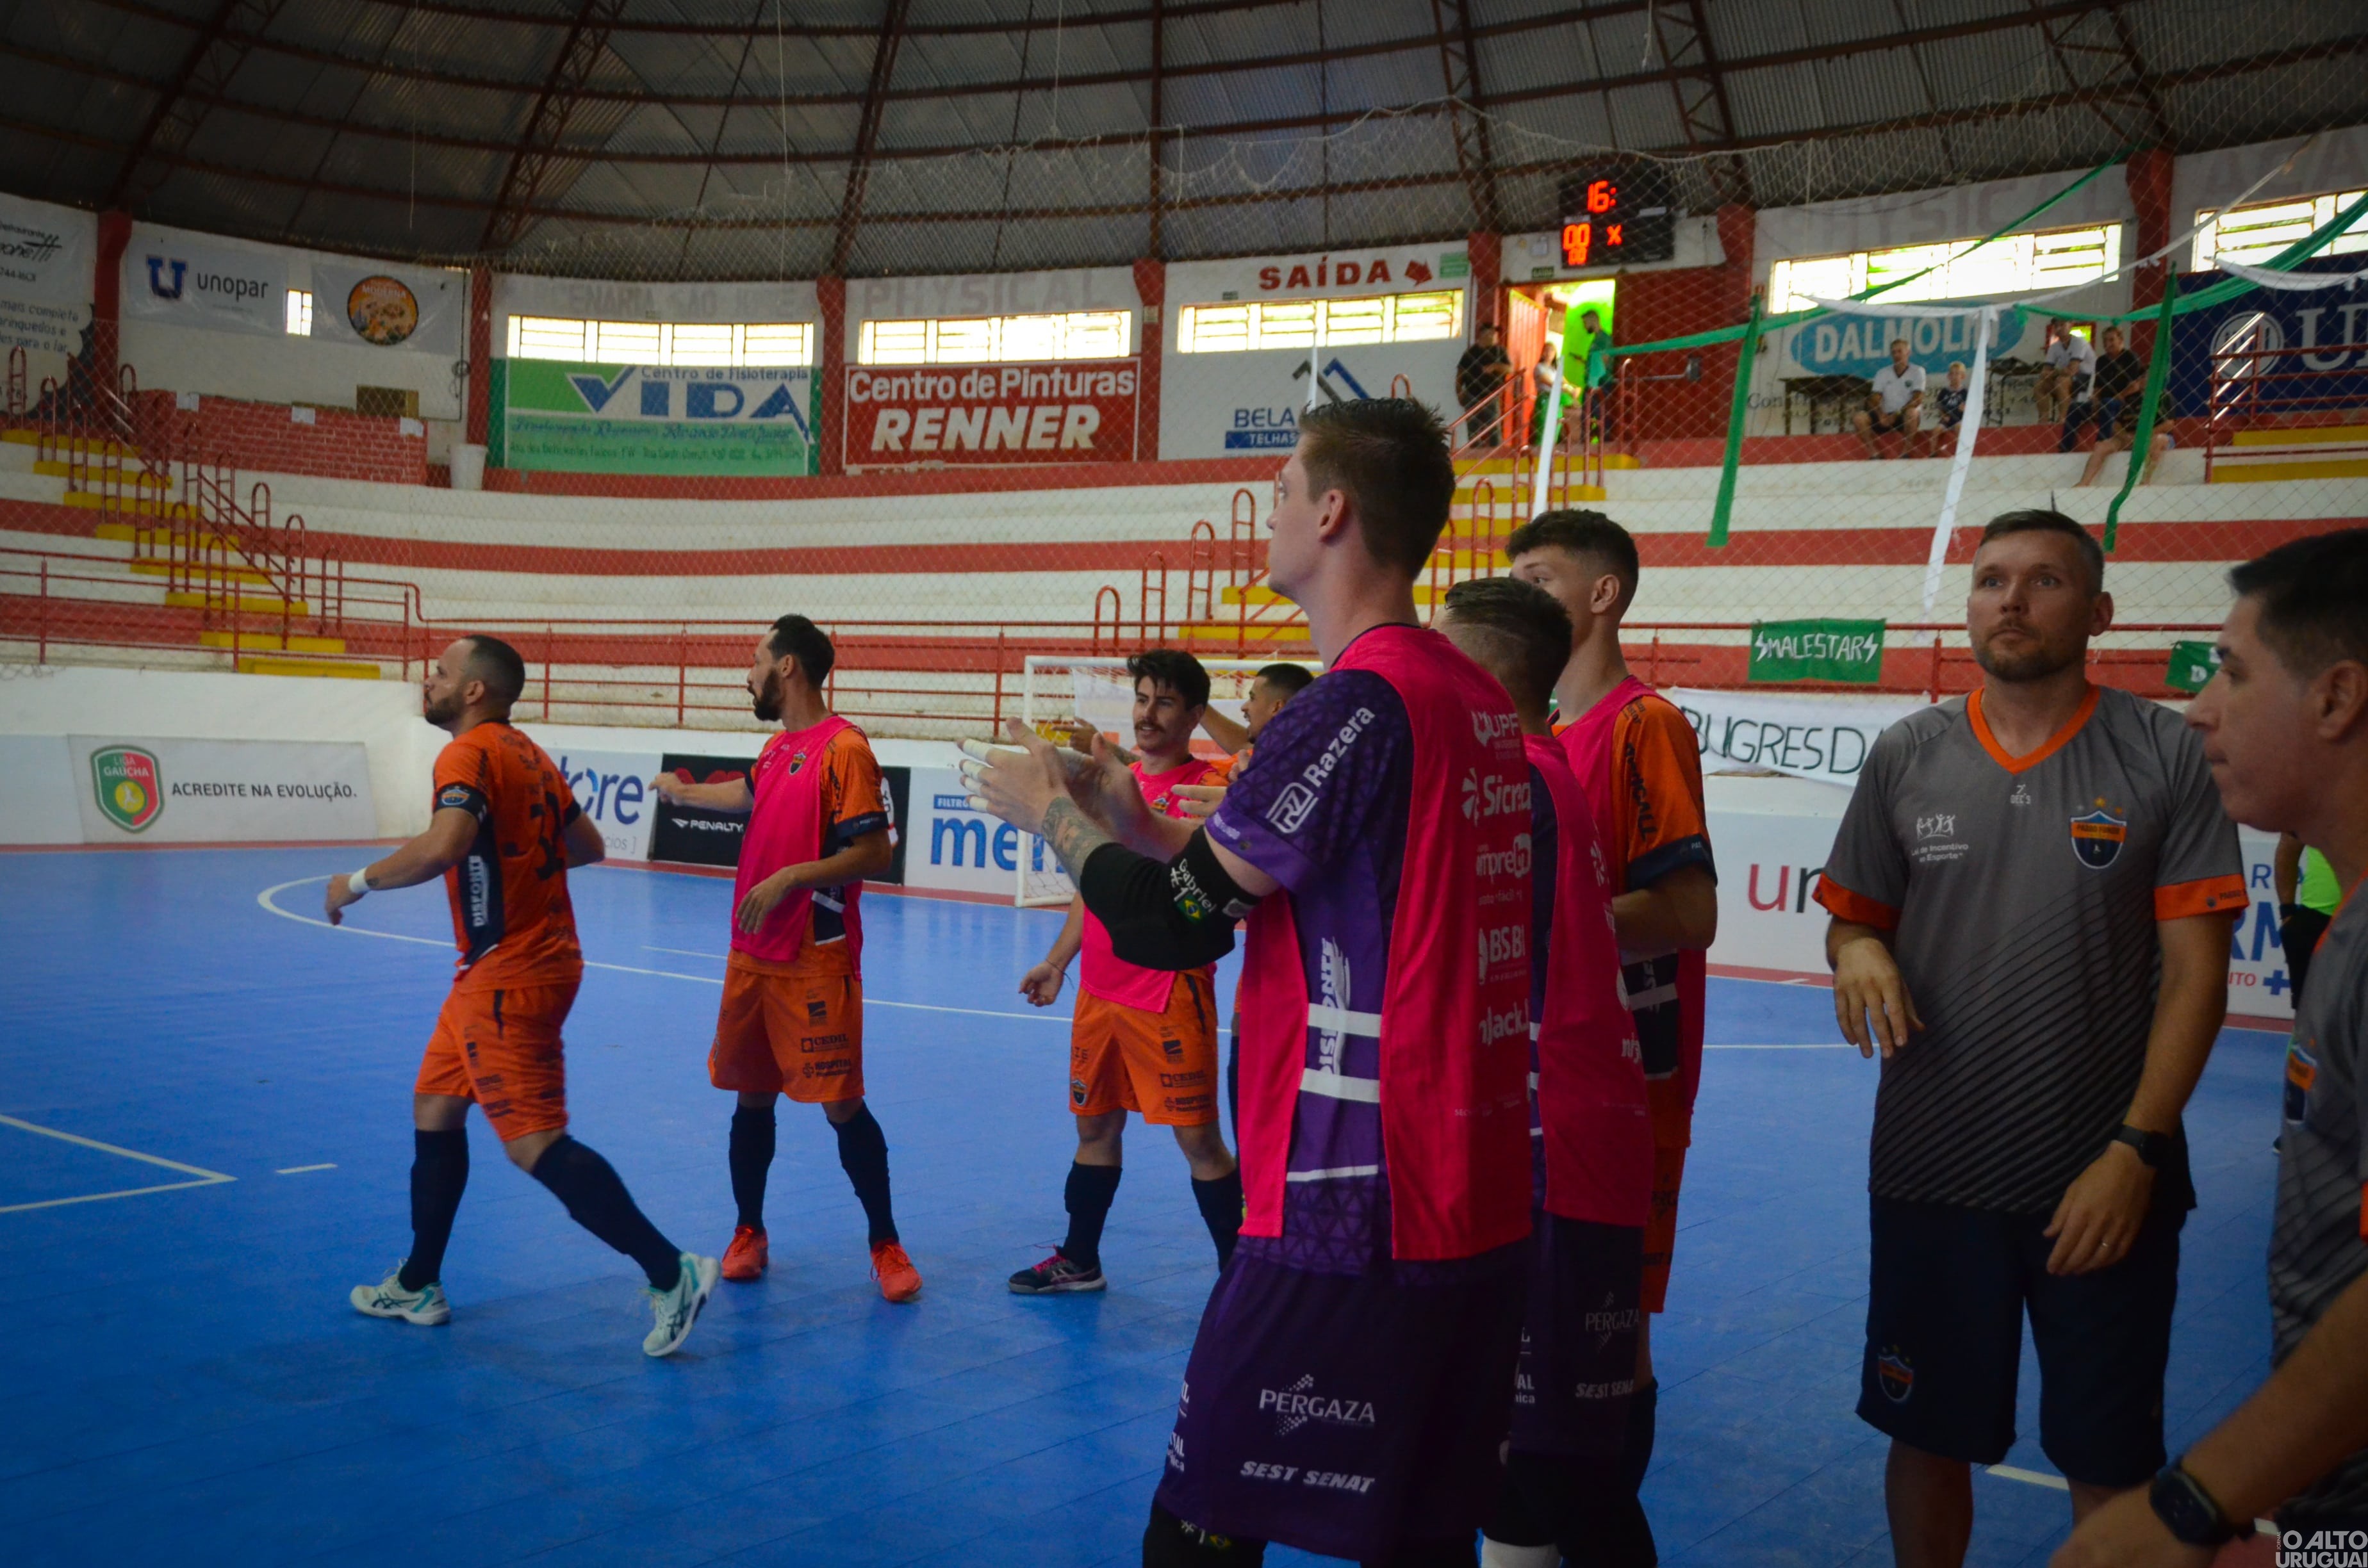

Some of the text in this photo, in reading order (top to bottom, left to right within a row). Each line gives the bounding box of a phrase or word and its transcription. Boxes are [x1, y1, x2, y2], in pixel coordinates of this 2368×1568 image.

[197, 272, 269, 301] unopar
[1259, 256, 1392, 290] SAÍDA
[863, 270, 1113, 318] PHYSICAL
[641, 367, 809, 382] Centro de Fisioterapia
[850, 367, 1135, 404] Centro de Pinturas
[569, 366, 814, 444] VIDA
[1234, 407, 1295, 427] BELA
[871, 404, 1101, 452] RENNER
[1250, 432, 1297, 446] TELHAS
[1303, 706, 1376, 788] Razera
[1681, 706, 1824, 771] BUGRES
[172, 781, 357, 803] ACREDITE NA EVOLUÇÃO.
[690, 819, 744, 833] PENALTY
[1927, 852, 1959, 862] Esporte
[1929, 842, 1969, 852] Incentivo
[1178, 858, 1218, 913] Gabriel
[1585, 1308, 1640, 1332] PERGAZA
[1258, 1387, 1376, 1423] PERGAZA
[1575, 1382, 1610, 1400] SEST
[1240, 1460, 1376, 1494] SEST SENAT
